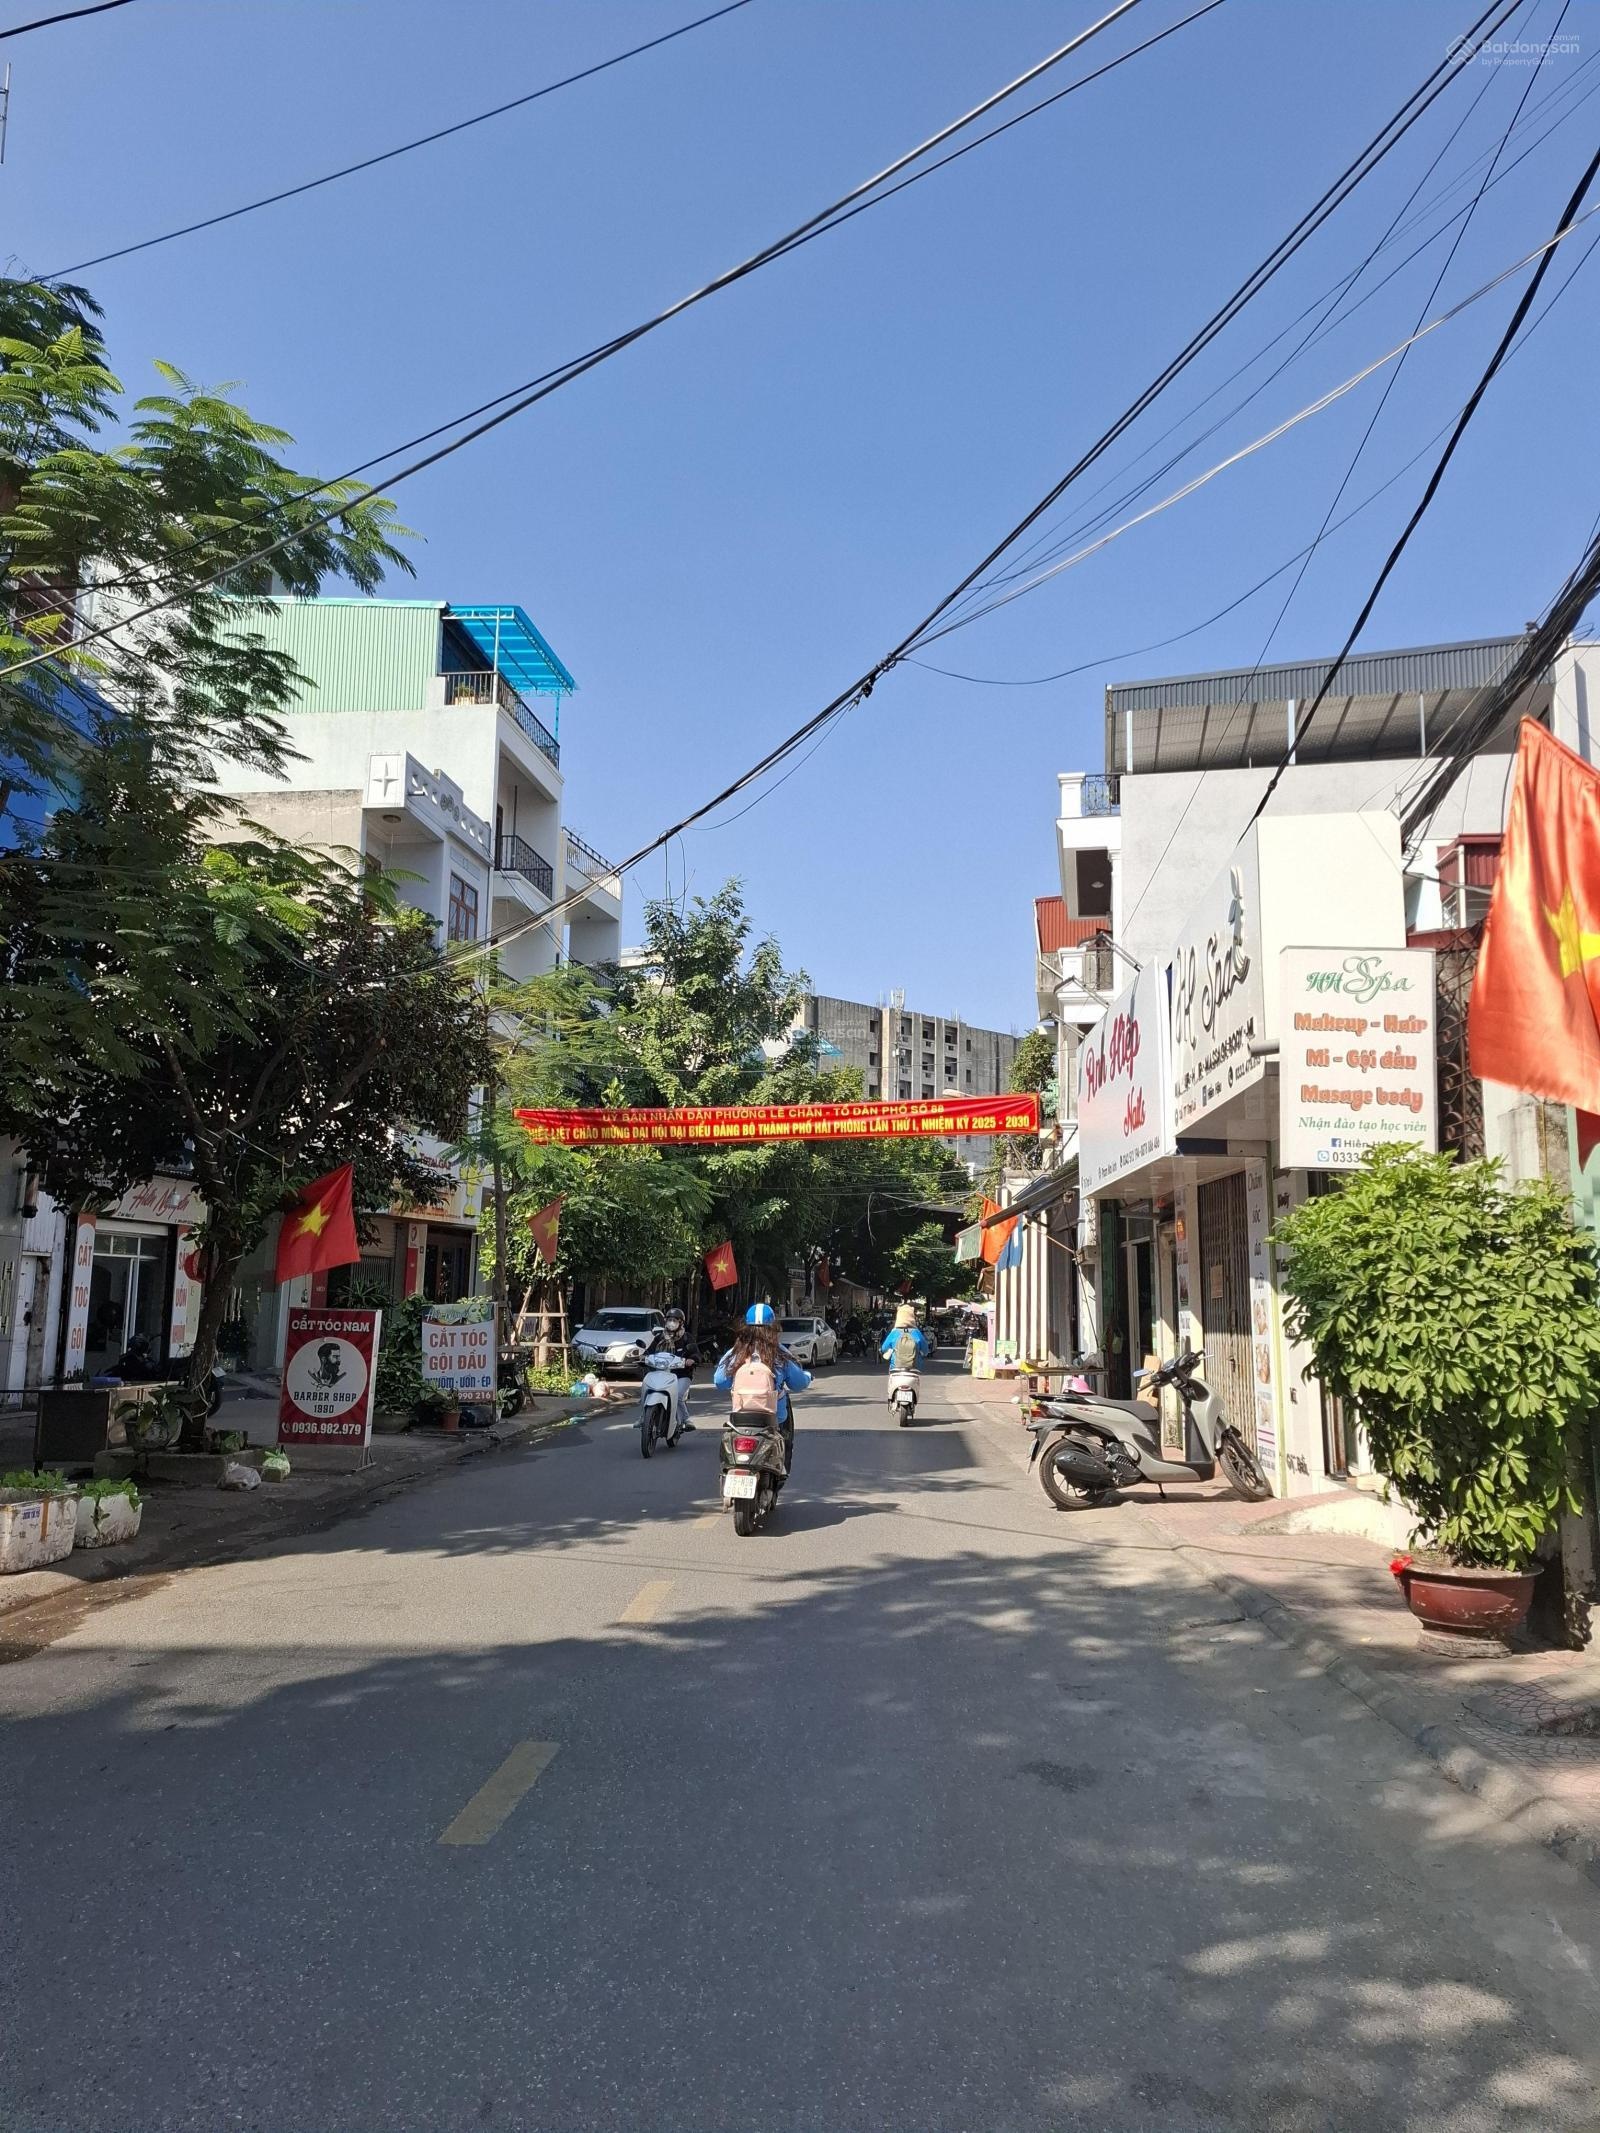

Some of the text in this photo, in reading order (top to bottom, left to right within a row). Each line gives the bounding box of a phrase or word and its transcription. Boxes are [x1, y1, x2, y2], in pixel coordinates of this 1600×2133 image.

[1306, 956, 1416, 1005] HH Spa
[1294, 1012, 1368, 1037] Makeup
[1383, 1014, 1428, 1033] Hair
[1085, 1047, 1107, 1103] Anh
[1109, 1012, 1141, 1081] Hiệp
[1306, 1048, 1330, 1067] Mi
[1301, 1085, 1423, 1113] Masage body
[622, 1112, 646, 1123] BAN
[650, 1109, 683, 1122] NHÂN
[687, 1107, 712, 1120] DÂN
[715, 1106, 766, 1120] PHƯỜNG
[770, 1105, 785, 1118] LÊ
[788, 1106, 822, 1118] CHÂN
[833, 1103, 850, 1117] TỔ
[853, 1103, 878, 1116] DÂN
[882, 1101, 908, 1115] PHỐ
[911, 1102, 928, 1114] SỐ
[1123, 1086, 1146, 1137] Nails
[573, 1124, 599, 1140] CHÀO
[601, 1124, 630, 1140] MỪNG
[632, 1127, 649, 1141] ĐẠI
[652, 1124, 668, 1140] HỘI
[670, 1125, 687, 1140] ĐẠI
[689, 1119, 711, 1138] BIỂU
[713, 1121, 740, 1138] ĐẢNG
[742, 1121, 756, 1137] BỘ
[759, 1121, 790, 1136] THÀNH
[792, 1119, 813, 1135] PHỐ
[815, 1118, 832, 1134] HẢI
[834, 1119, 867, 1134] PHÒNG
[869, 1116, 889, 1133] LẦN
[891, 1116, 911, 1132] THỨ
[921, 1115, 954, 1133] NHIỆM
[956, 1114, 970, 1130] KỲ
[972, 1115, 996, 1129] 2025
[1006, 1115, 1030, 1128] 2030
[1298, 1117, 1428, 1133] Nhận đào tạo học viên
[74, 1282, 89, 1308] TÓC
[318, 1318, 341, 1331] TÓC
[429, 1327, 487, 1348] CẮT TÓC
[429, 1349, 487, 1373] GỘI ĐẦU
[293, 1391, 357, 1402] BARBER SHOP
[475, 1391, 491, 1400] 216
[291, 1422, 361, 1435] 0936.982.979
